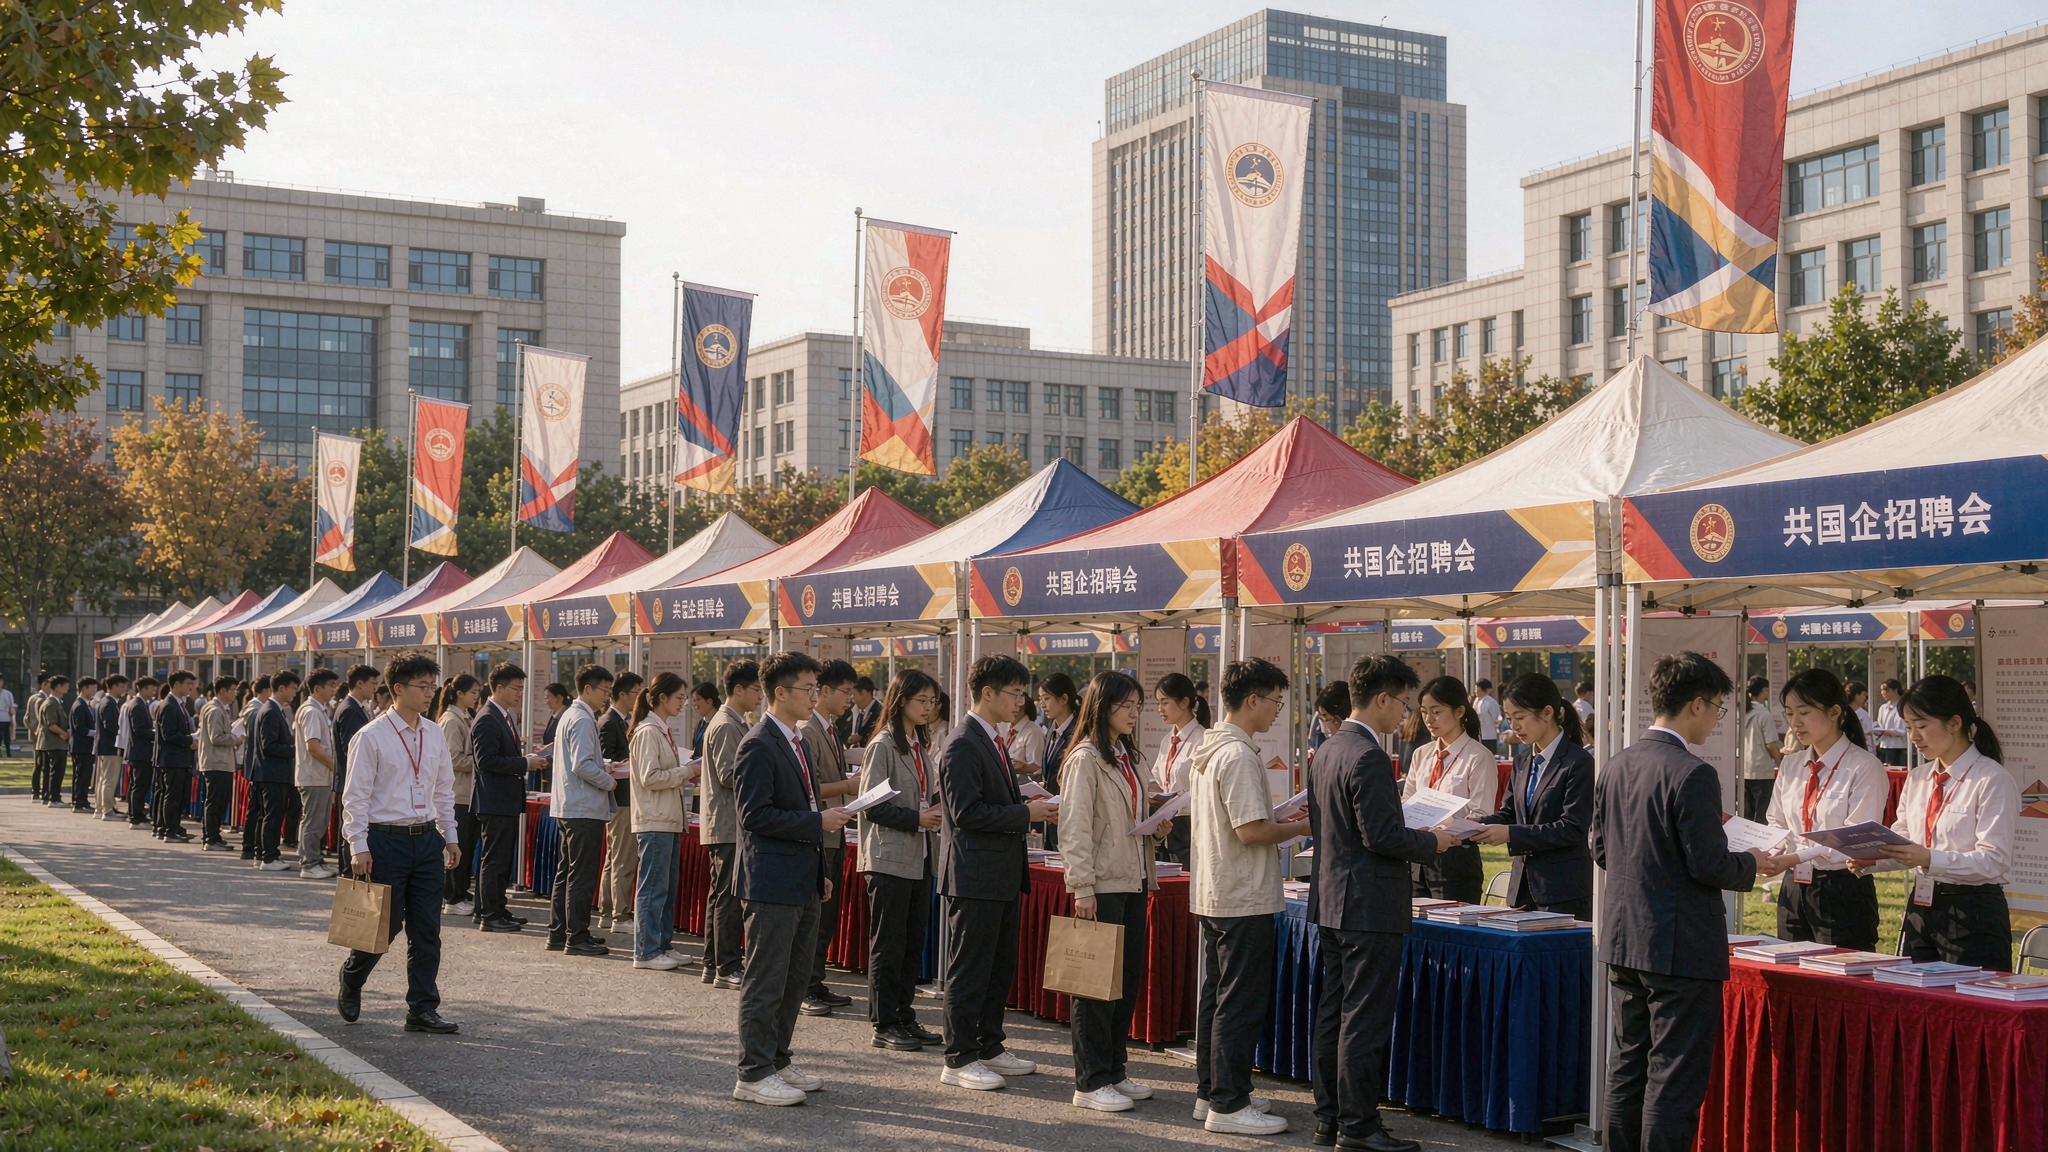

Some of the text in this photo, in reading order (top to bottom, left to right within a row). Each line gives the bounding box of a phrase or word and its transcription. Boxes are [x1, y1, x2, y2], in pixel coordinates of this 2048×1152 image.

[1782, 492, 1992, 547] 共国企招聘会
[1344, 538, 1475, 579] 共国企招聘会
[1046, 565, 1138, 597] 共国企招聘会
